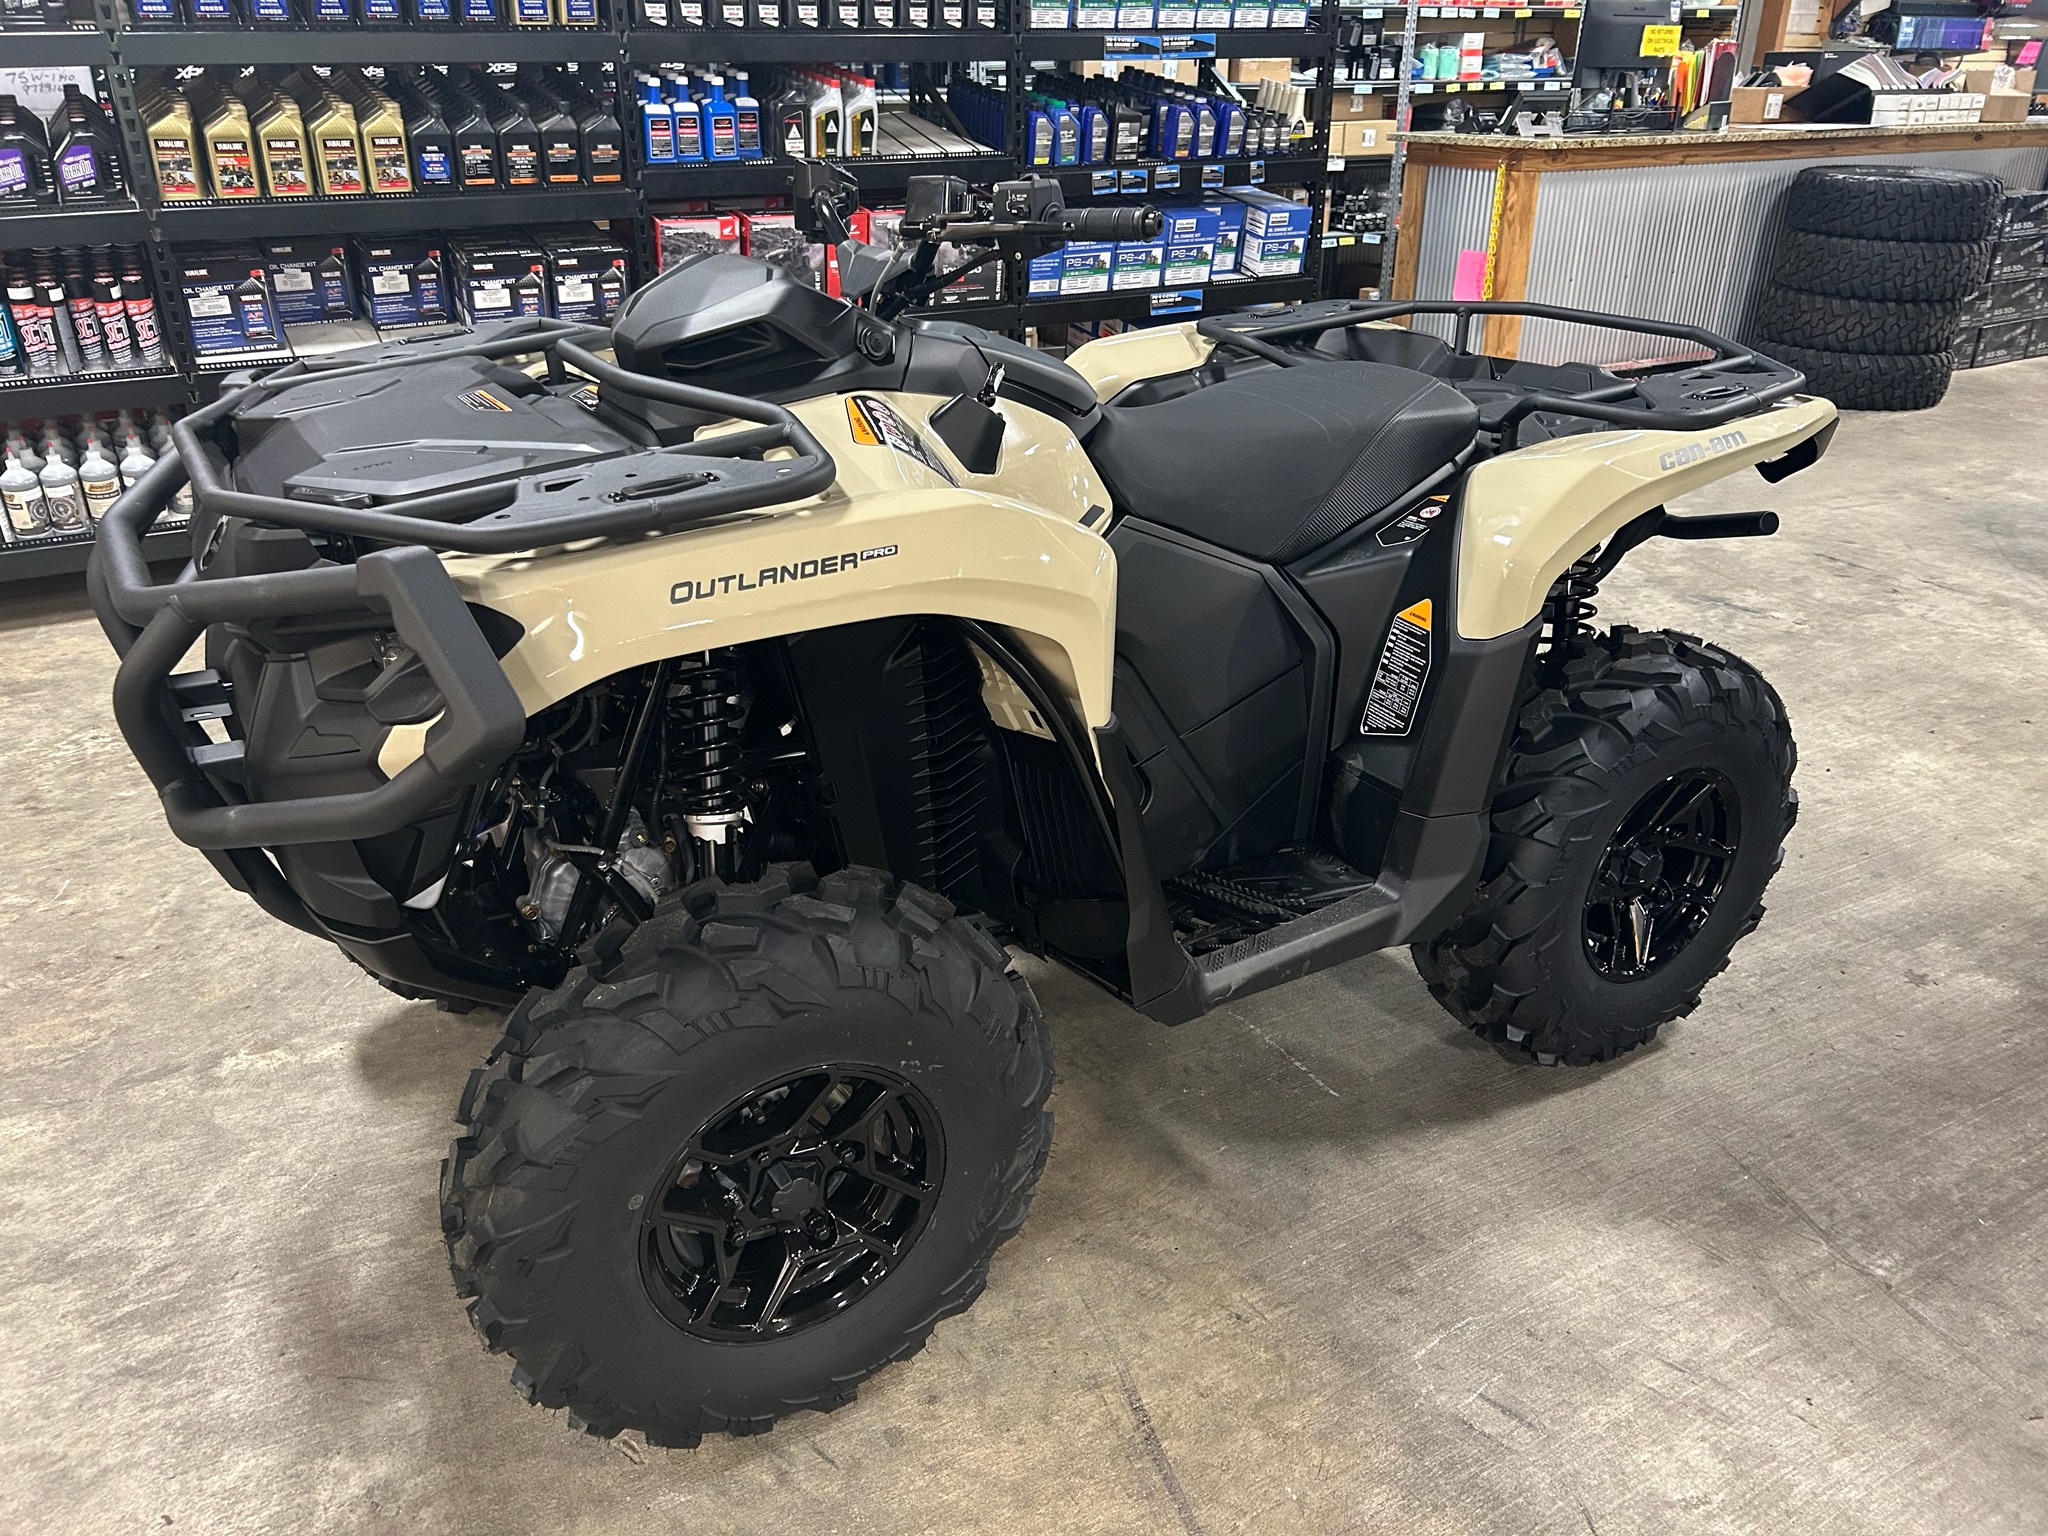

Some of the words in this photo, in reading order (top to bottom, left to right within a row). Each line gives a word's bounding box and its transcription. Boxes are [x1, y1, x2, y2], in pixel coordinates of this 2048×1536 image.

[486, 63, 518, 74] XPS
[157, 140, 186, 149] YAMALUBE
[216, 142, 244, 150] YAMALUBE
[270, 140, 296, 148] YAMALUBE
[62, 164, 80, 180] GEAR
[80, 160, 94, 174] OIL
[1264, 243, 1289, 252] PS-4
[1119, 253, 1146, 262] PS-4
[1172, 248, 1198, 258] PS-4
[1066, 257, 1094, 268] PS-4
[184, 268, 208, 277] YAMALUBE
[75, 314, 100, 338] SC1
[104, 318, 129, 343] SC1
[136, 315, 158, 341] SC1
[201, 346, 243, 355] PERFORMANCE
[1659, 430, 1748, 471] can-am
[670, 552, 858, 604] OUTLANDER
[862, 545, 897, 560] PRO
